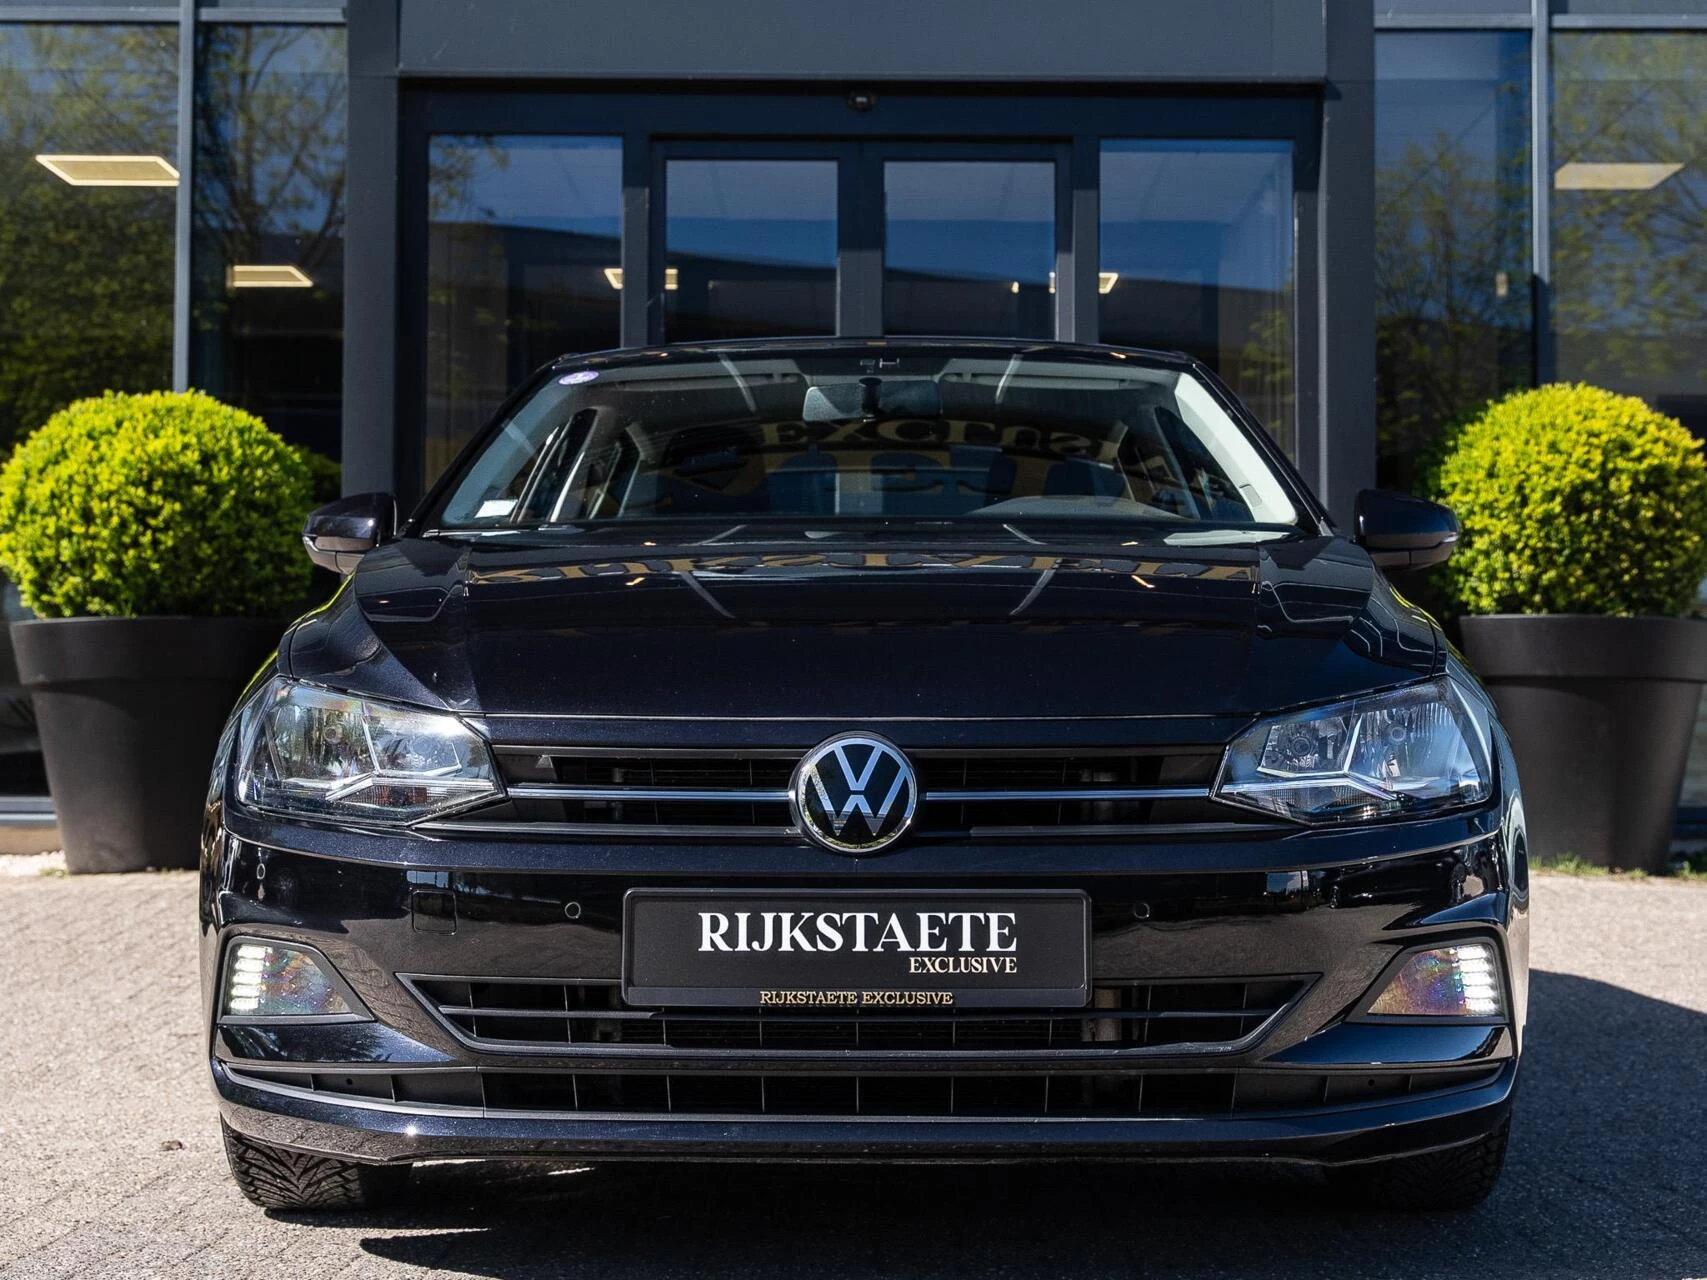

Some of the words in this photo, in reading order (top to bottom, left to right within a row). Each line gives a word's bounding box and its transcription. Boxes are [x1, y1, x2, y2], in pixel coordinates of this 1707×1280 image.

[697, 911, 1018, 952] RIJKSTAETE
[908, 956, 1018, 975] EXCLUSIVE
[759, 990, 858, 1005] RIJKSTAETE
[861, 990, 954, 1006] EXCLUSIVE
